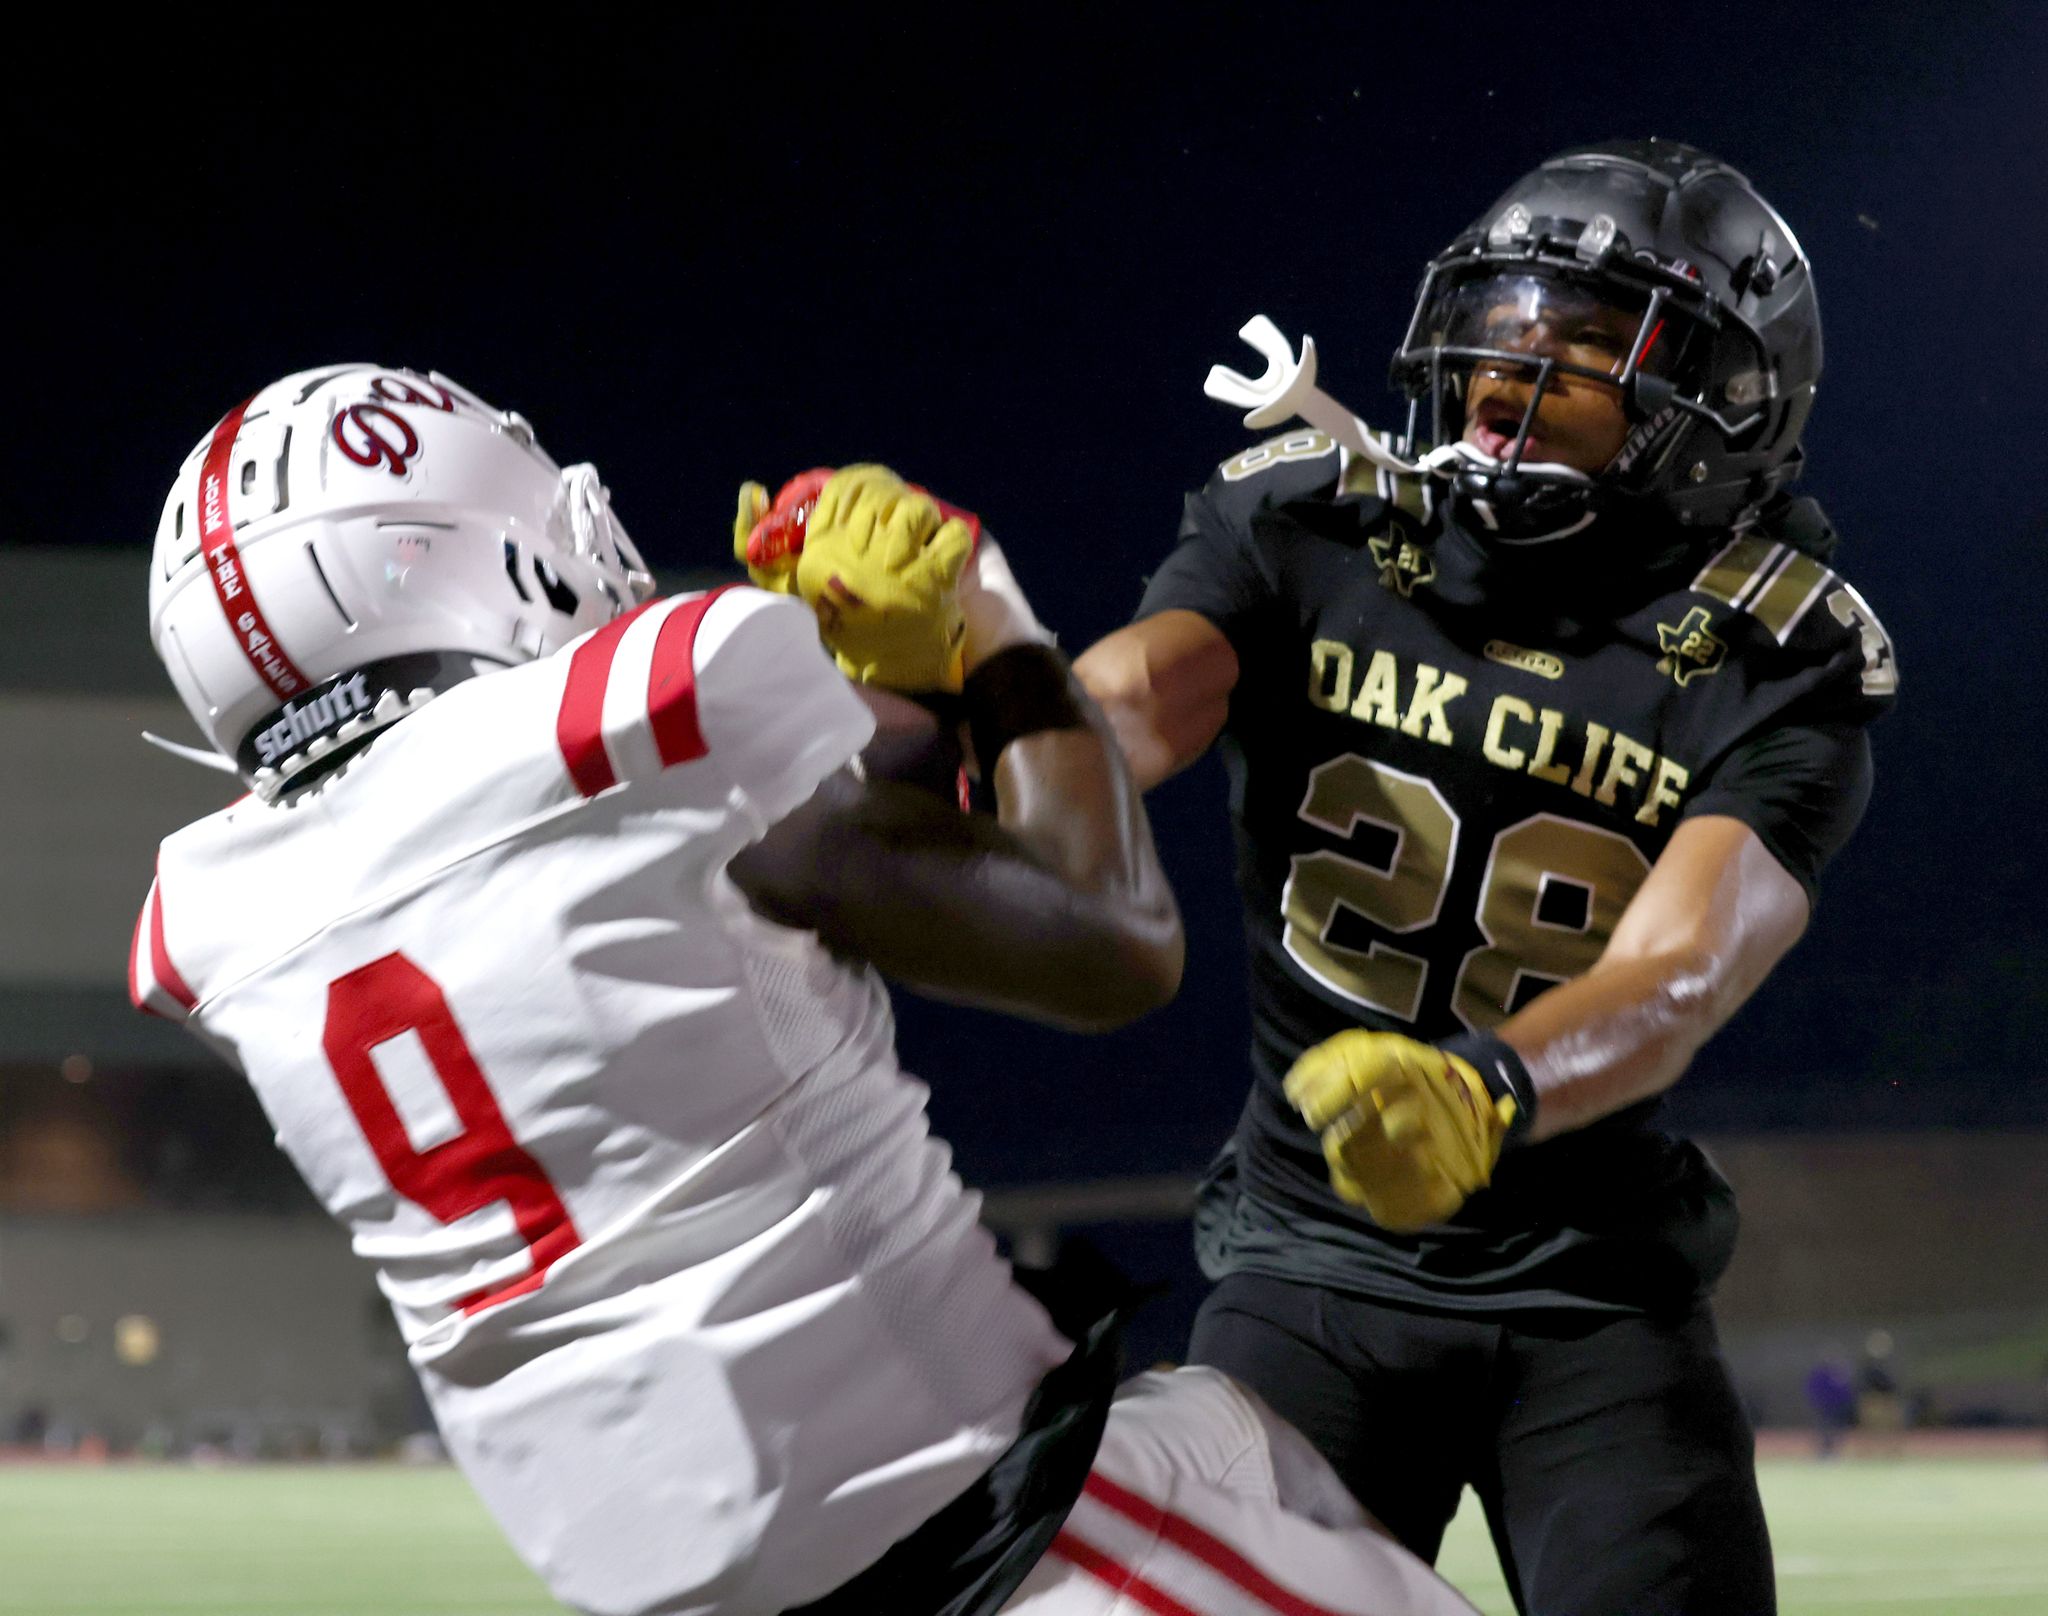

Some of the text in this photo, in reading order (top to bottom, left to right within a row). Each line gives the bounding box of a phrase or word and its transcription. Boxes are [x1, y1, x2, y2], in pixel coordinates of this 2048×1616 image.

[204, 473, 297, 692] LOCK THE GATES
[254, 671, 371, 766] schutt
[1308, 638, 1689, 827] OAK CLIFF
[1281, 752, 1653, 1037] 28
[322, 949, 582, 1318] 9
